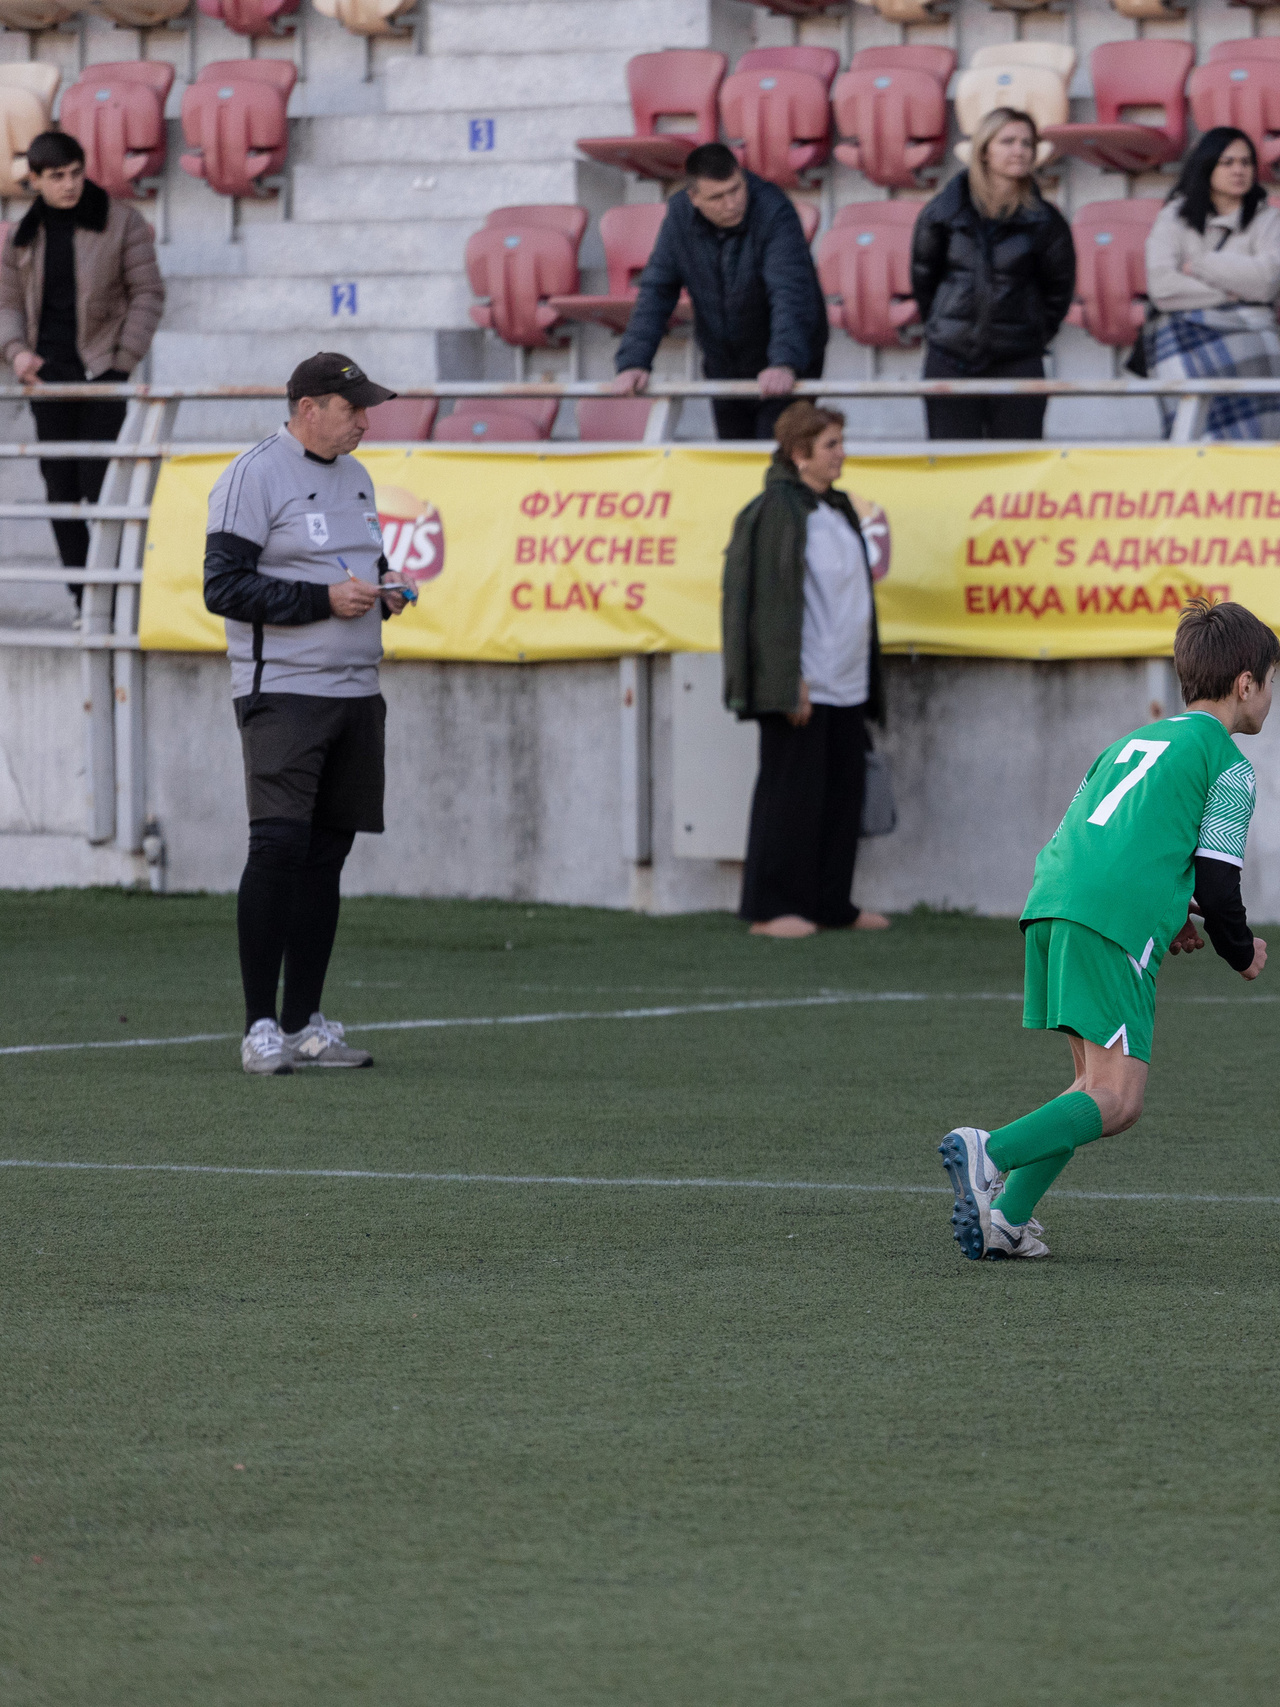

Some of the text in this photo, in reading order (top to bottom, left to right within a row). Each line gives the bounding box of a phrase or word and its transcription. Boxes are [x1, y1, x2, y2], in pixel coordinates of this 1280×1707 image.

[472, 119, 493, 151] 3
[334, 283, 355, 316] 2
[519, 489, 672, 519] ФУТБОЛ
[514, 536, 678, 565] ВКУСНЕЕ
[1086, 738, 1172, 826] 7
